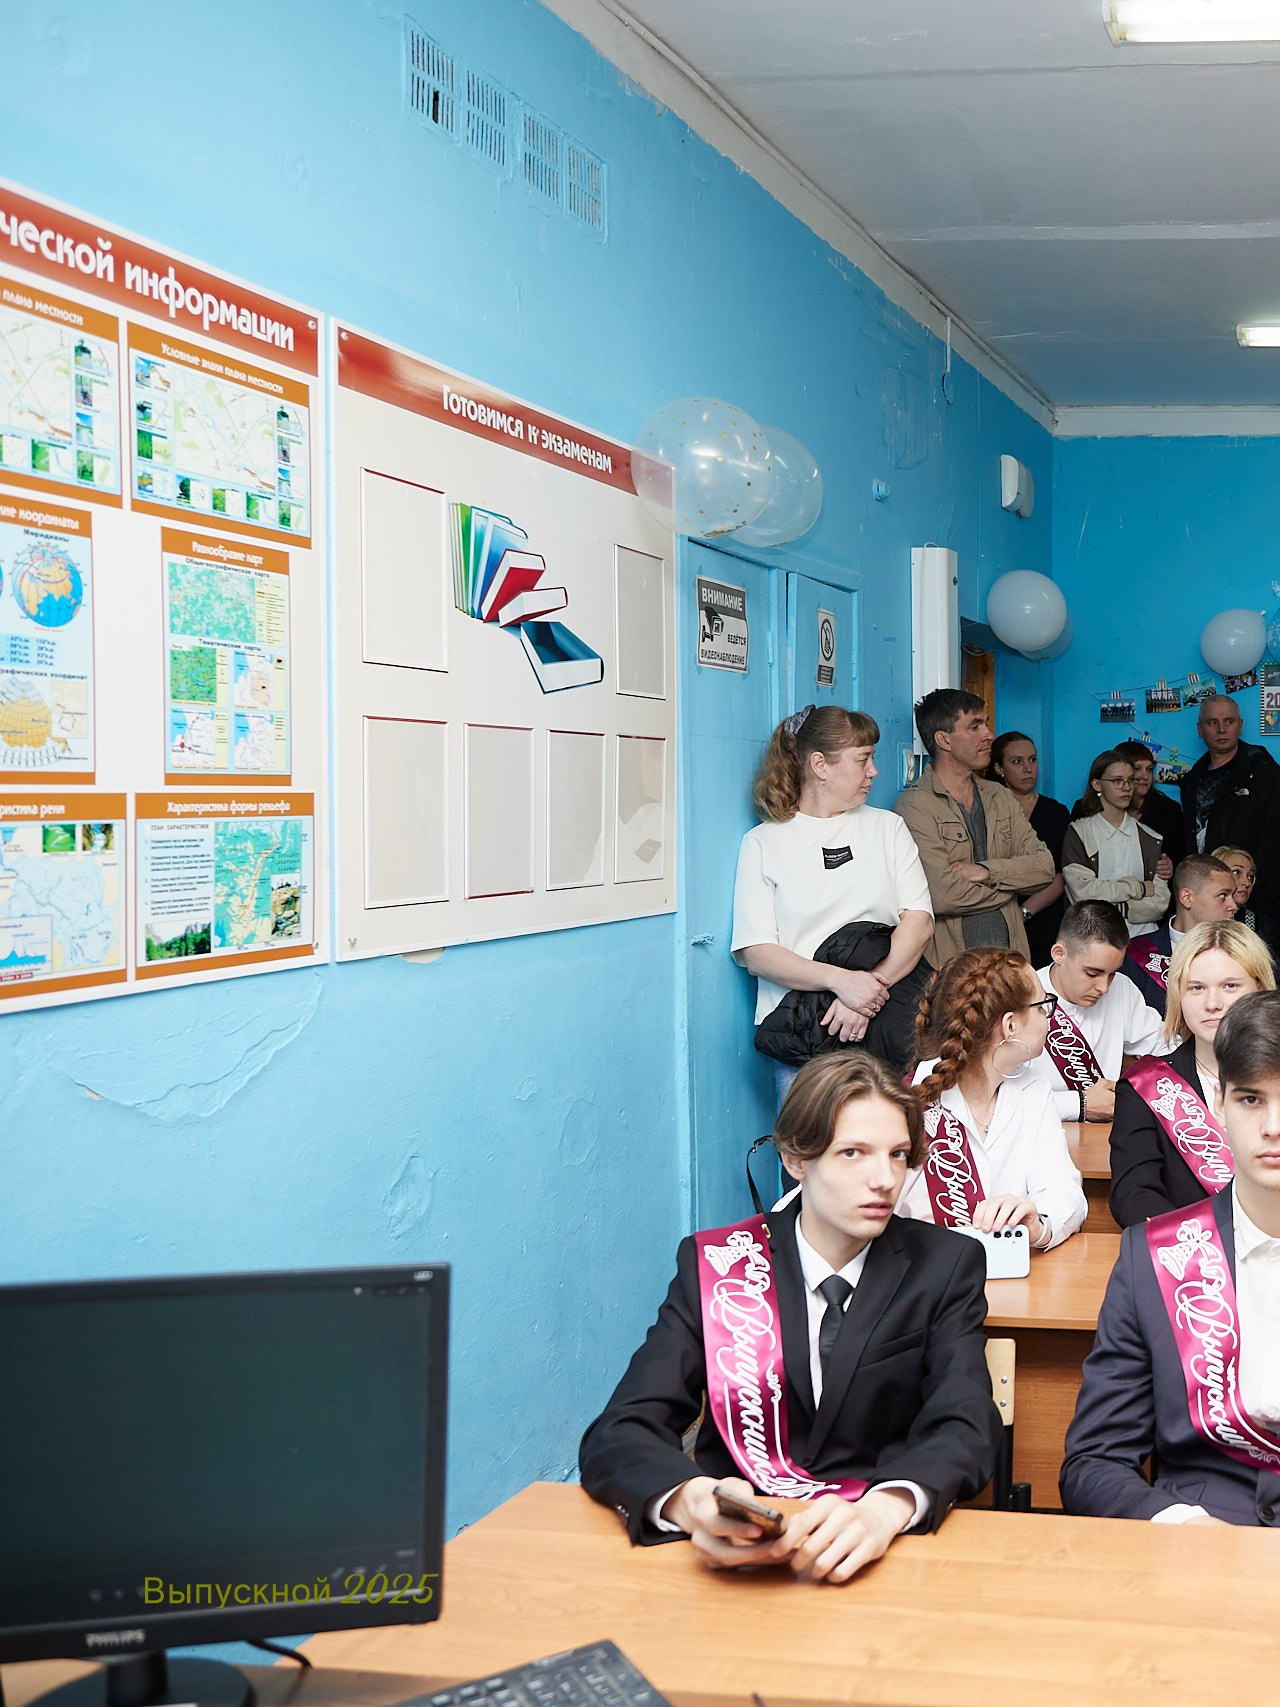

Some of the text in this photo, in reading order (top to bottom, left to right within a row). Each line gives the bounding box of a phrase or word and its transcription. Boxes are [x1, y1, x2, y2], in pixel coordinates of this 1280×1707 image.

[125, 260, 294, 352] информации
[442, 384, 612, 475] Готовимся к экзаменам
[19, 508, 80, 530] координаты
[701, 587, 743, 612] ВНИМАНИЕ
[700, 648, 745, 666] ВИДЕОНАБЛЮДЕНИЕ
[167, 800, 291, 816] Характеристика формы рельефа
[86, 1629, 146, 1648] PHILIPS
